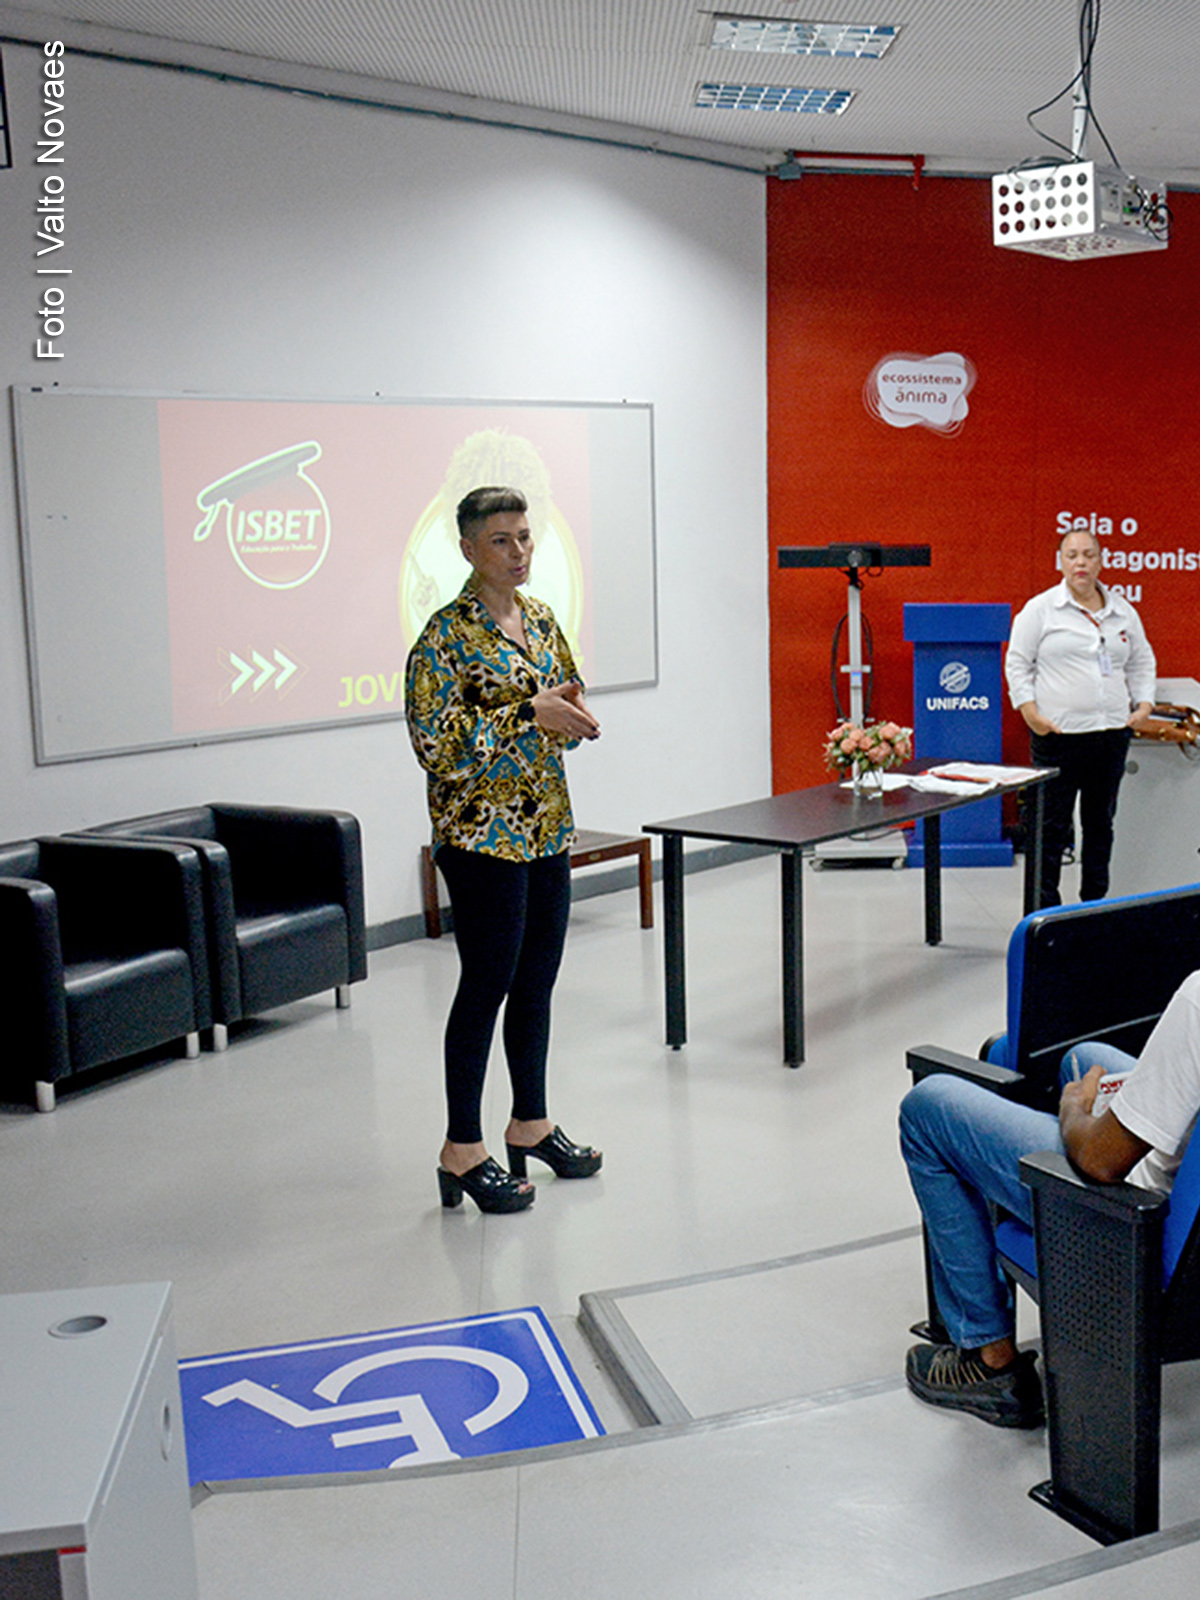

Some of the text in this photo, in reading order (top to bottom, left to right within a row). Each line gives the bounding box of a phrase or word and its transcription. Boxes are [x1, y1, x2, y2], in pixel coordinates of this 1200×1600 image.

[882, 373, 962, 385] ecossistema
[235, 509, 322, 543] ISBET
[1056, 511, 1138, 537] Seja o
[1103, 584, 1142, 602] eu
[926, 696, 989, 711] UNIFACS
